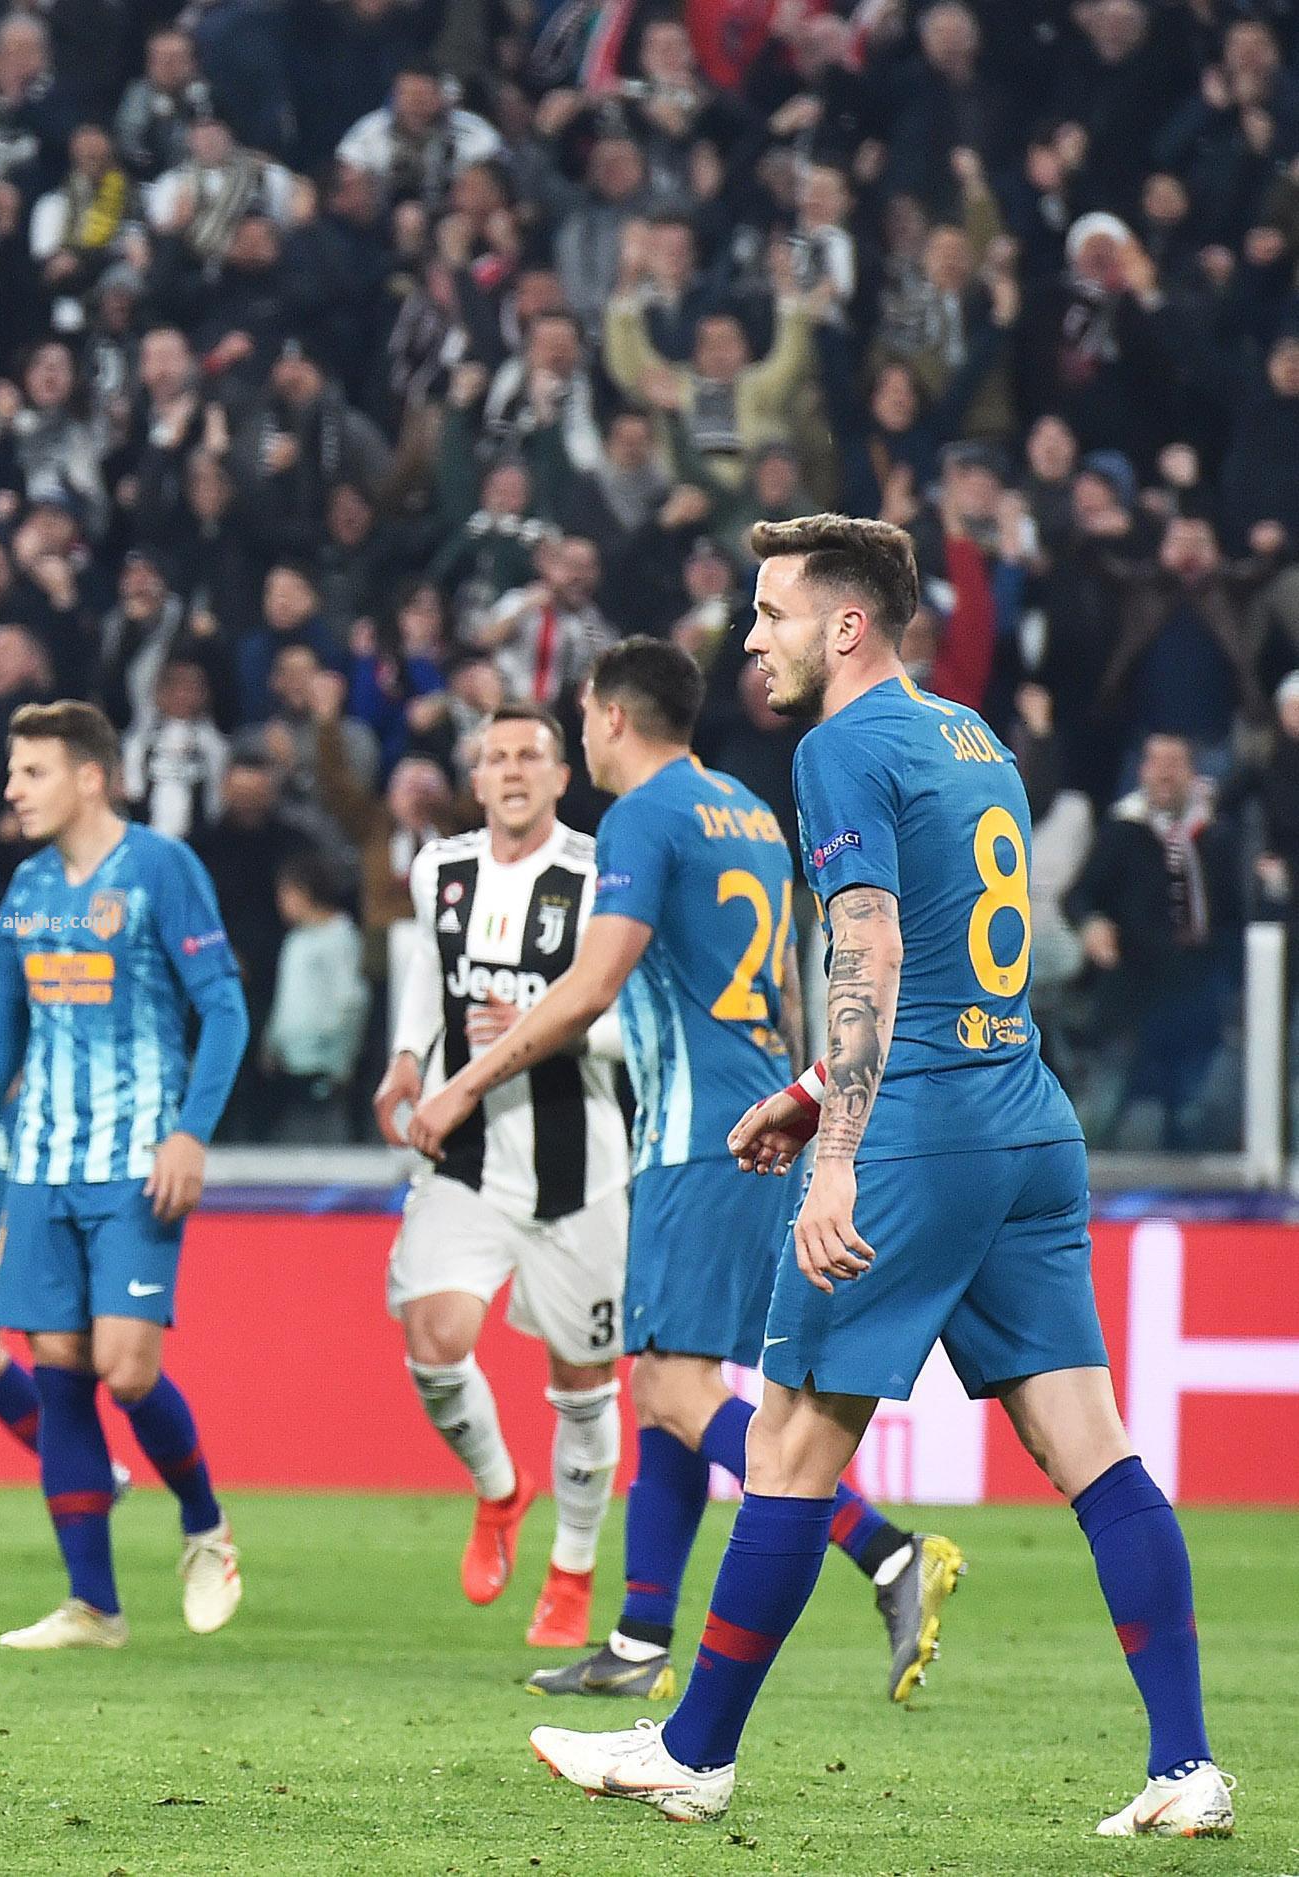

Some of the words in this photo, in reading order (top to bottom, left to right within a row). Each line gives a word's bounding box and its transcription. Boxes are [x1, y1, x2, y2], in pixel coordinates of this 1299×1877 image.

[823, 833, 860, 857] RESPECT
[968, 806, 1031, 997] 8
[591, 1299, 615, 1349] 3
